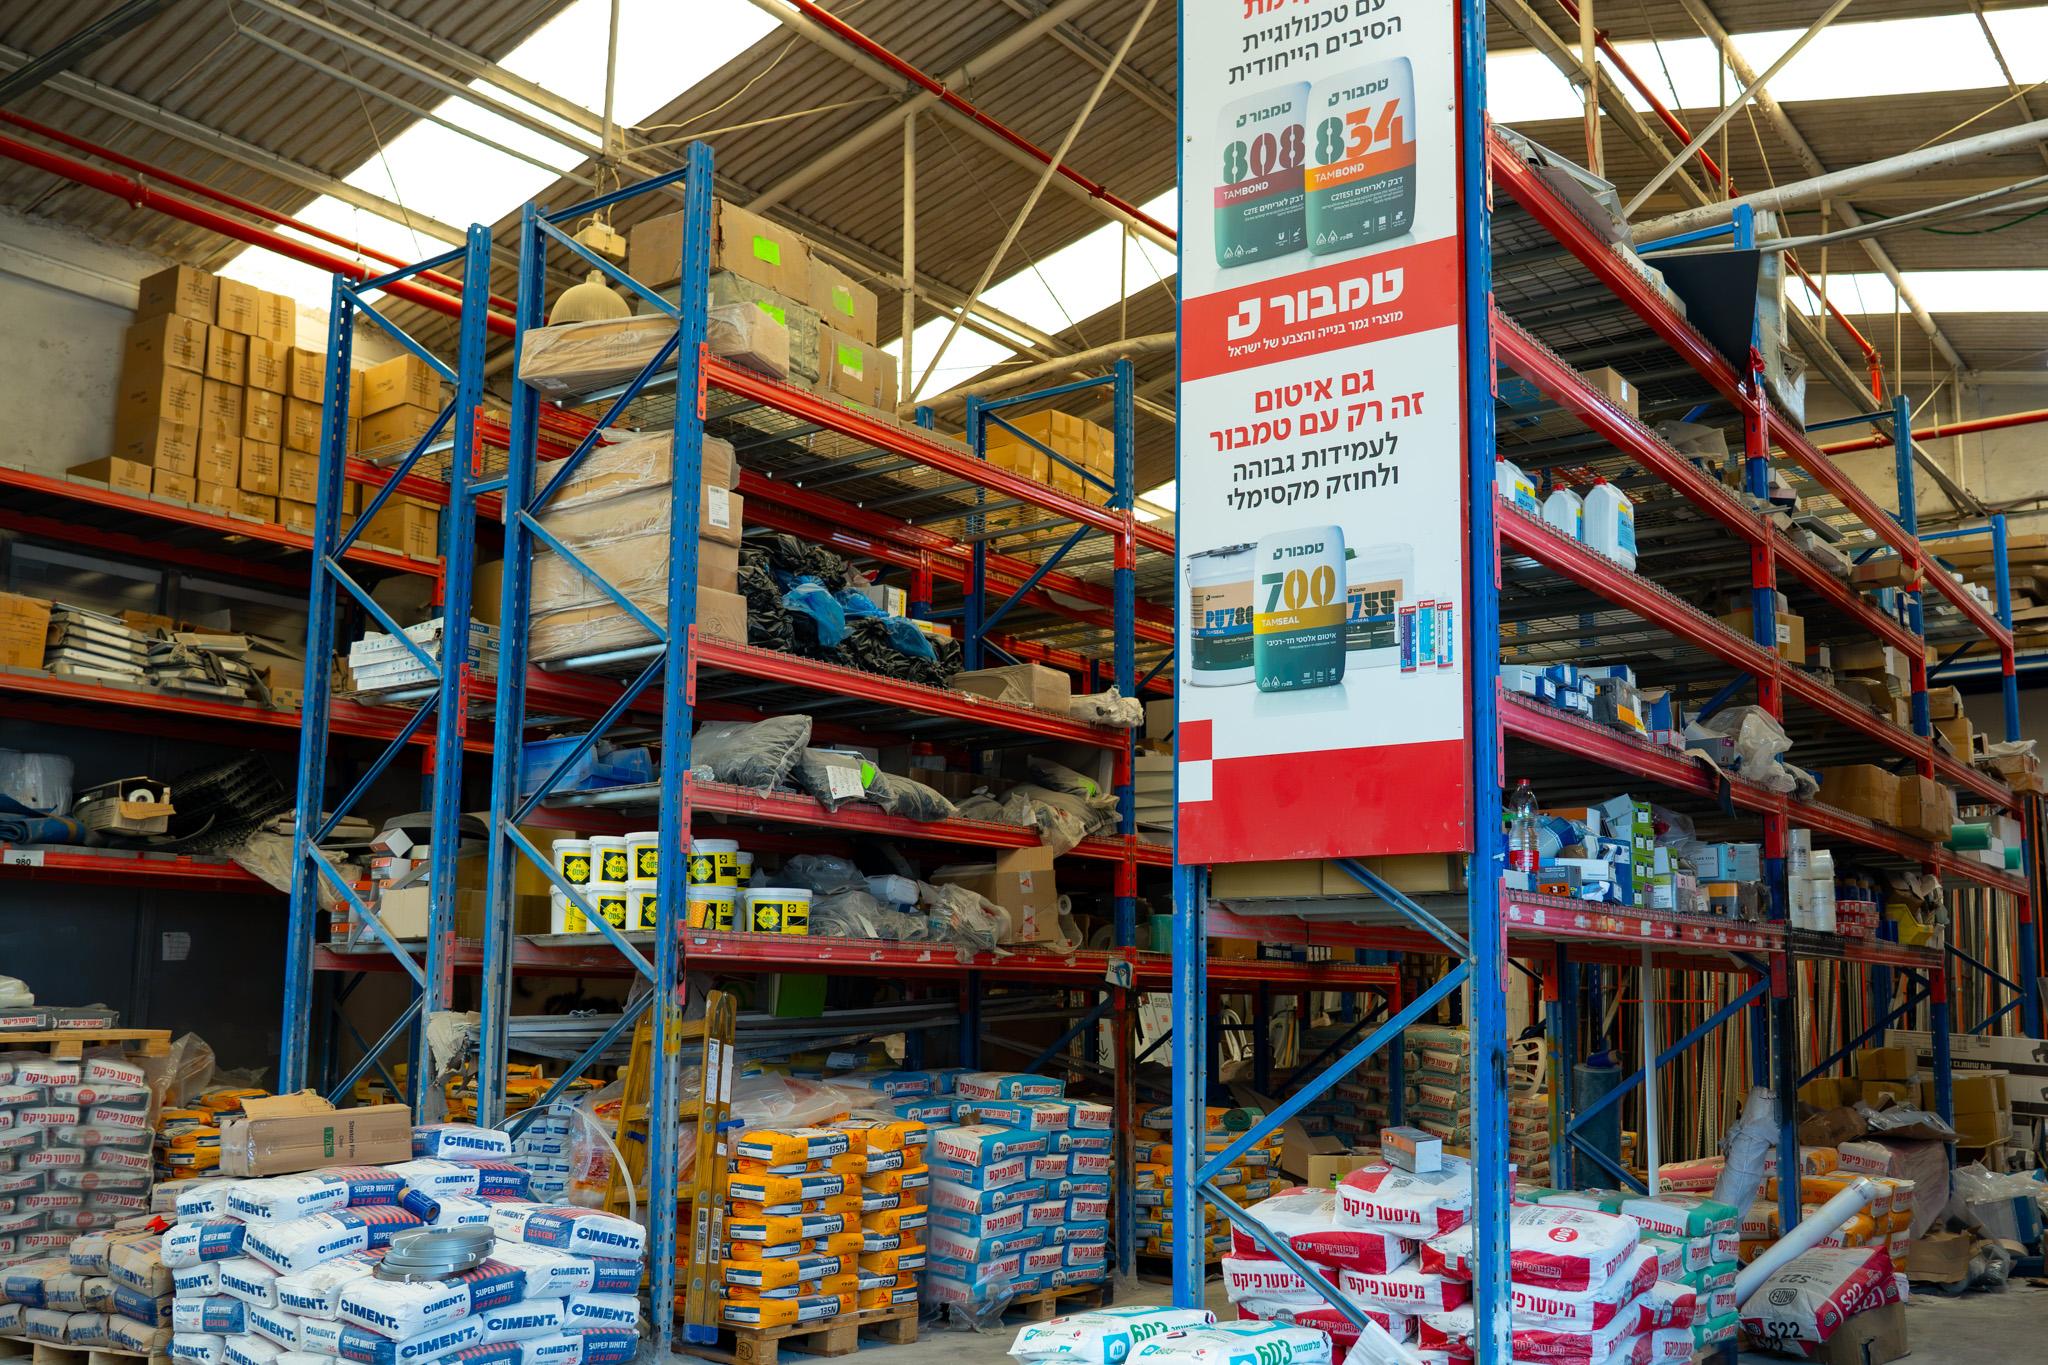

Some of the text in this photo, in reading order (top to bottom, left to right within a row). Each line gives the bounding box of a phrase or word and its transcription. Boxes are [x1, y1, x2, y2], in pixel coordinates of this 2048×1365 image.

[1243, 5, 1348, 53] טכנולוגיית
[1229, 16, 1402, 84] הסיבים הייחודית
[1342, 78, 1389, 102] טמבור
[1249, 102, 1292, 123] טמבור
[1315, 98, 1403, 166] 834
[1223, 124, 1306, 185] 808
[1314, 163, 1365, 183] TAMBOND
[1223, 182, 1269, 200] TAMBOND
[1269, 267, 1404, 325] טמבור
[1228, 311, 1404, 358] מוצרי גמר בנייה והצבע של ישראל
[1255, 369, 1375, 414] גם איטום
[1209, 391, 1425, 452] זה רק עם טמבור
[1233, 431, 1399, 482] לעמידות גבוהה
[1227, 462, 1399, 511] ולחוזק מקסימלי
[1284, 542, 1325, 557] טמבור
[1261, 564, 1336, 614] 700
[1347, 590, 1396, 620] 755
[1262, 615, 1300, 628] TAMSEAL
[15, 857, 32, 867] 980
[829, 1142, 845, 1154] 135N
[354, 1183, 396, 1193] SUPER WHITE
[484, 1175, 521, 1185] SUPER WHITE
[823, 1183, 840, 1195] 135N
[881, 1199, 897, 1209] 135N
[824, 1222, 841, 1234] 135N
[882, 1236, 898, 1248] 135N
[600, 1268, 636, 1277] SUPER WHITE
[820, 1265, 837, 1277] 135N
[475, 1281, 515, 1298] SUPER WHITE
[879, 1277, 895, 1288] 135N
[1840, 1282, 1864, 1312] S22
[820, 1304, 837, 1316] 135N
[1768, 1321, 1803, 1339] S22
[588, 1340, 628, 1351] SUPER WHITE
